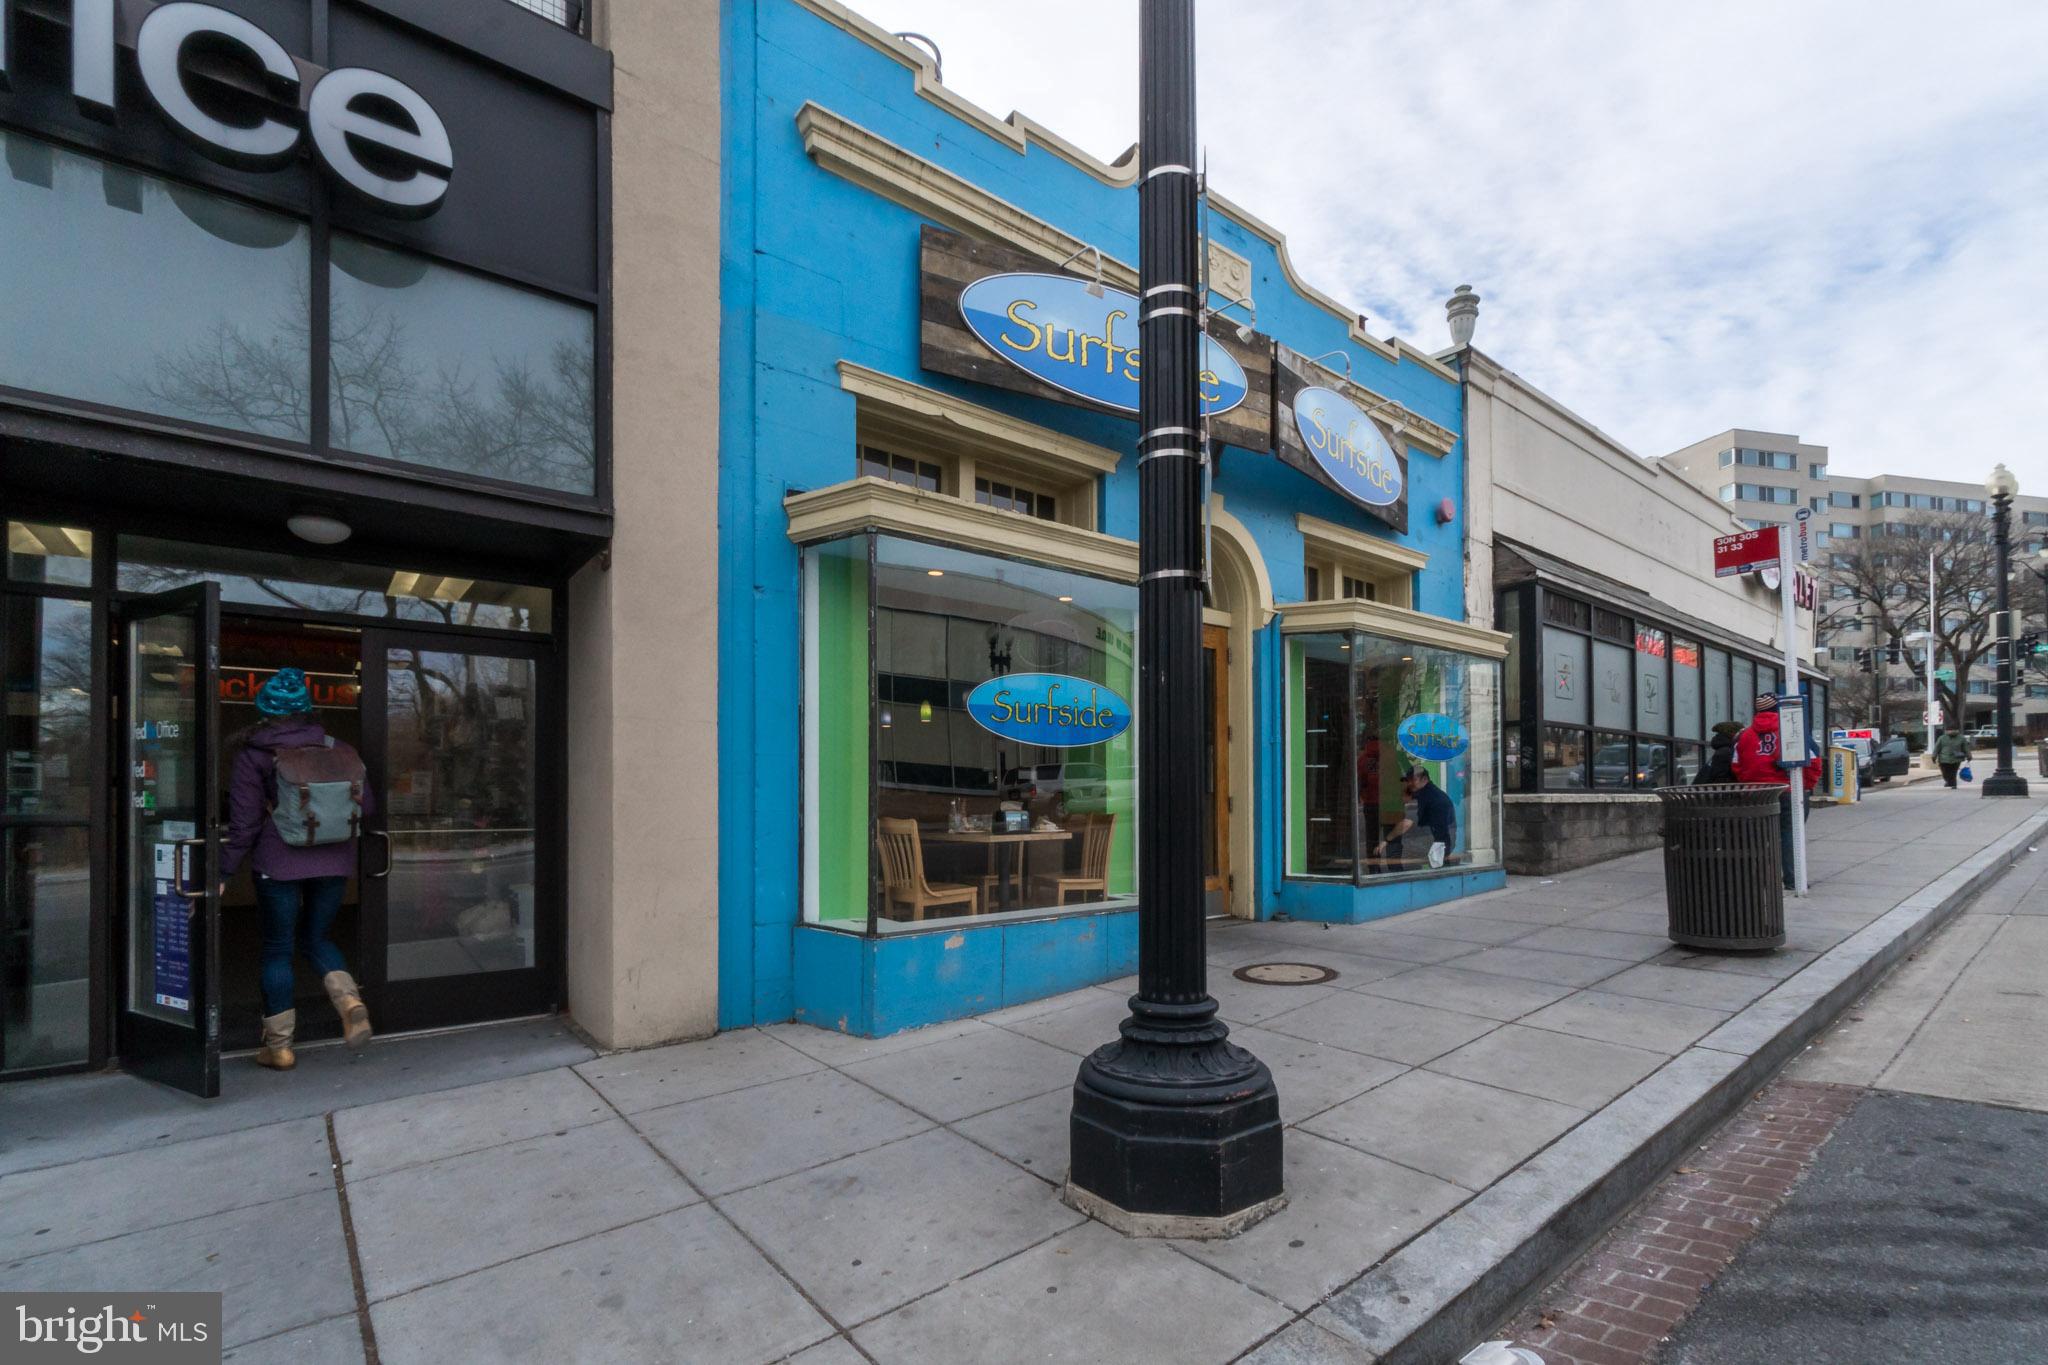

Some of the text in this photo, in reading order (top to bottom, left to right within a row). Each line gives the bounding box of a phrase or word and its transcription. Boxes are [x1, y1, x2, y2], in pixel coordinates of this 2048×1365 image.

[0, 0, 453, 206] ice
[1000, 299, 1220, 402] Surfse
[1311, 407, 1394, 494] Surfside
[1717, 531, 1759, 546] 30N 30S
[1717, 542, 1743, 554] 31 33
[1799, 521, 1808, 561] metrobus
[991, 683, 1113, 728] Surfside
[1756, 732, 1776, 756] B
